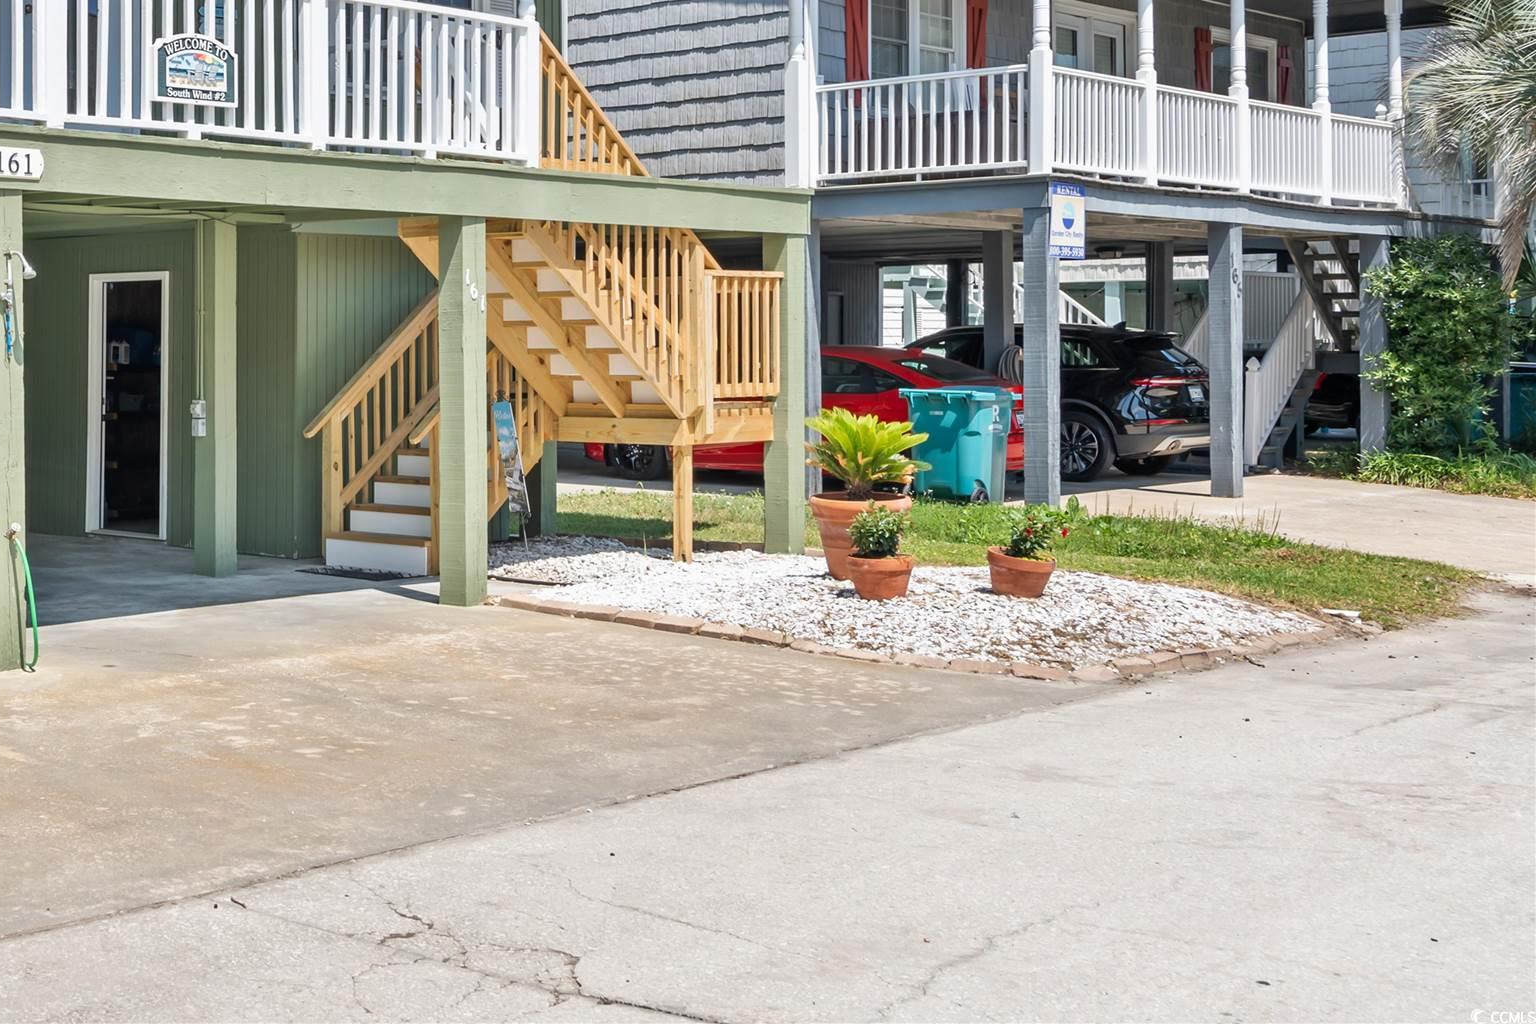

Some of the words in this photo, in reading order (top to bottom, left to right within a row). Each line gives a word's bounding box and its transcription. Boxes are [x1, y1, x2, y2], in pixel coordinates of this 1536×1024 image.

[164, 38, 213, 56] WELCOME
[215, 45, 228, 61] TO
[167, 87, 191, 98] South
[192, 89, 213, 101] Wind
[214, 92, 226, 102] #2
[466, 268, 485, 311] 161
